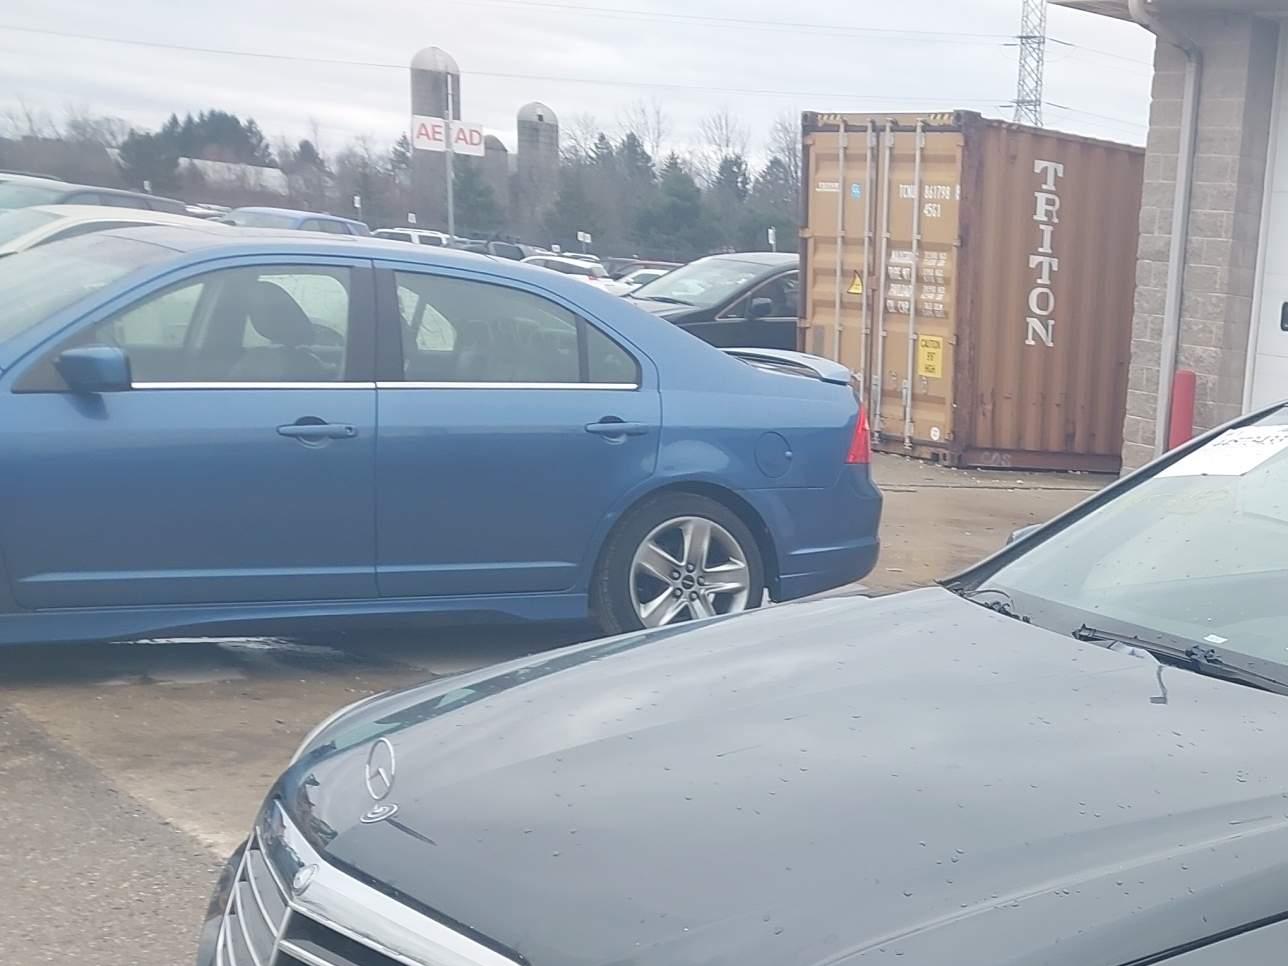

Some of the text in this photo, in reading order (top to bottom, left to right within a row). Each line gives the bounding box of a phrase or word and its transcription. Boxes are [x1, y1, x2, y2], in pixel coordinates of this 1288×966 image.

[416, 123, 443, 142] AE
[455, 127, 482, 146] AD
[1024, 159, 1065, 347] TRITON
